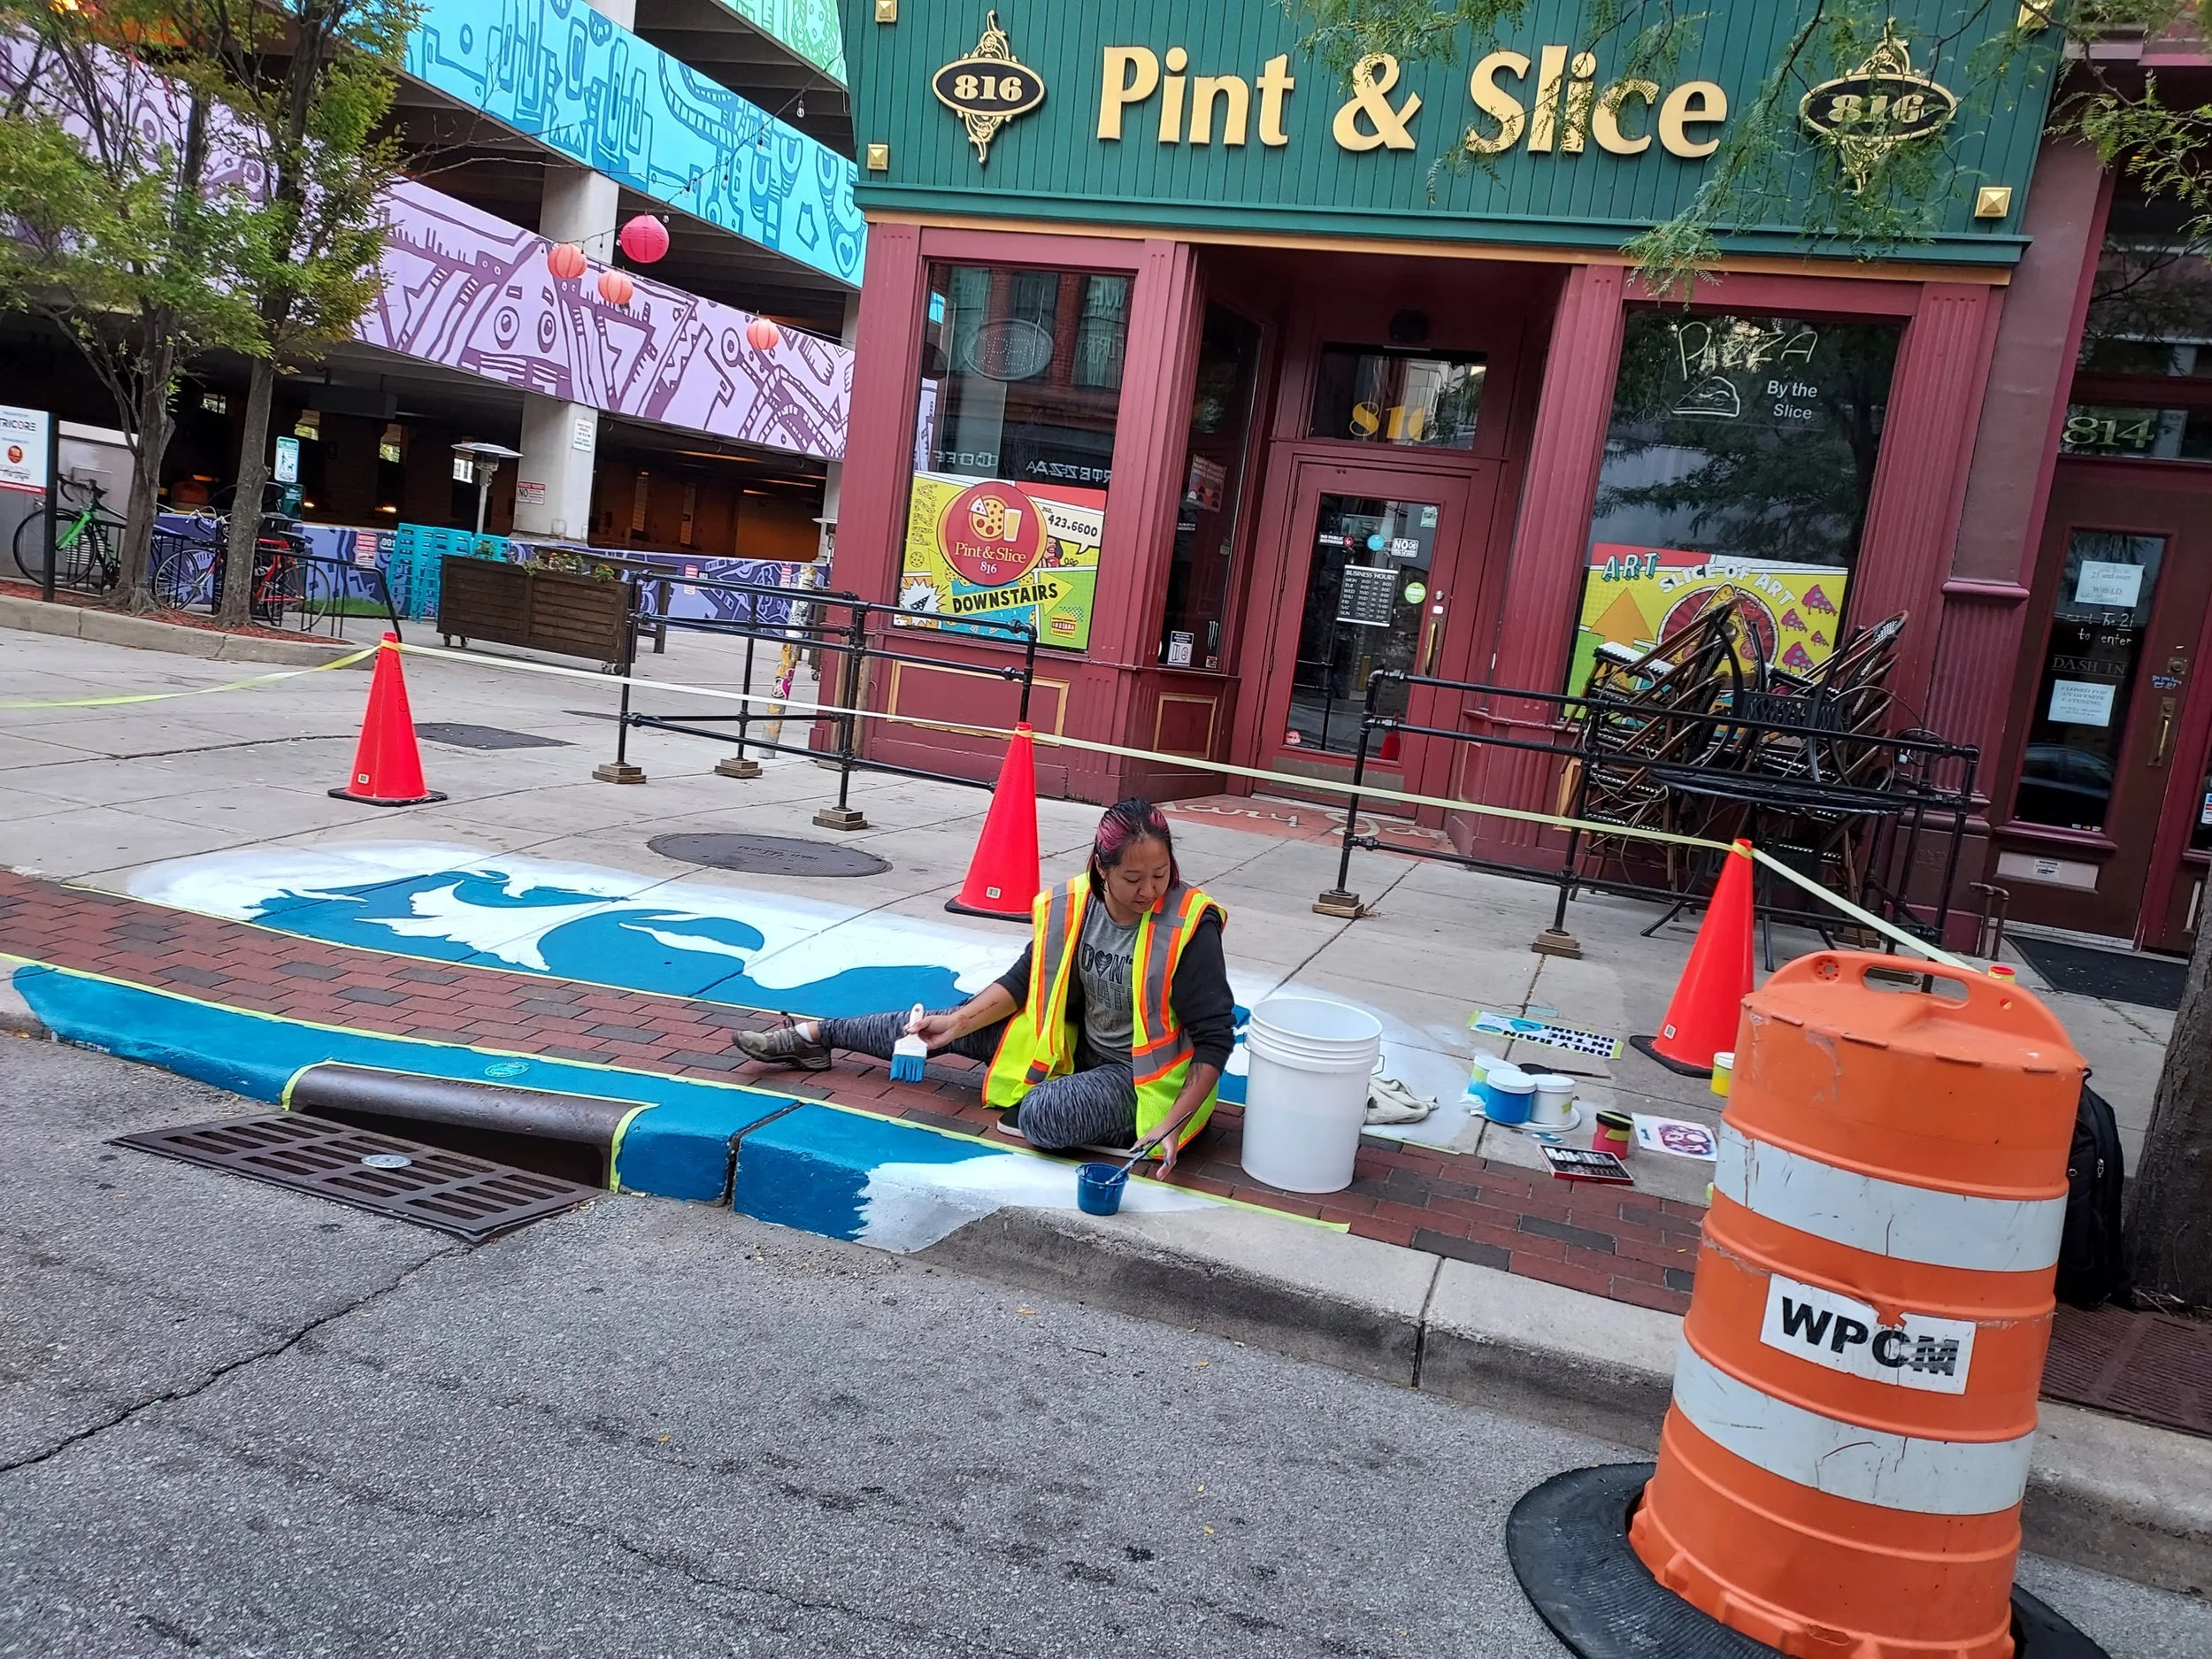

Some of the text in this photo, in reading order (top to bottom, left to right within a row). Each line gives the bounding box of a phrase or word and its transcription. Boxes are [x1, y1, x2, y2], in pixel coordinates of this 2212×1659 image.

[954, 73, 1025, 103] 816
[1096, 45, 1728, 158] Pint & Slice
[1828, 93, 1925, 124] 816
[1768, 380, 1817, 398] By the
[1349, 402, 1439, 442] 816
[1774, 403, 1812, 419] Slice
[2062, 416, 2155, 449] 814
[1048, 514, 1098, 538] 423.6600
[955, 541, 1027, 565] Pint & Slice
[1394, 539, 1409, 549] NO
[979, 561, 998, 574] 816
[1346, 570, 1372, 579] BUSINESS
[1601, 551, 1661, 582] ART
[1658, 563, 1797, 606] SLICE OF ART
[952, 581, 1058, 614] DOWNSTAIRS
[2078, 628, 2131, 646] to enter
[2052, 657, 2127, 675] DASH IN
[1502, 1030, 1611, 1057] ONLY RAIN
[1543, 1025, 1615, 1043] DRAIN!
[1548, 1033, 1614, 1050] IN THE
